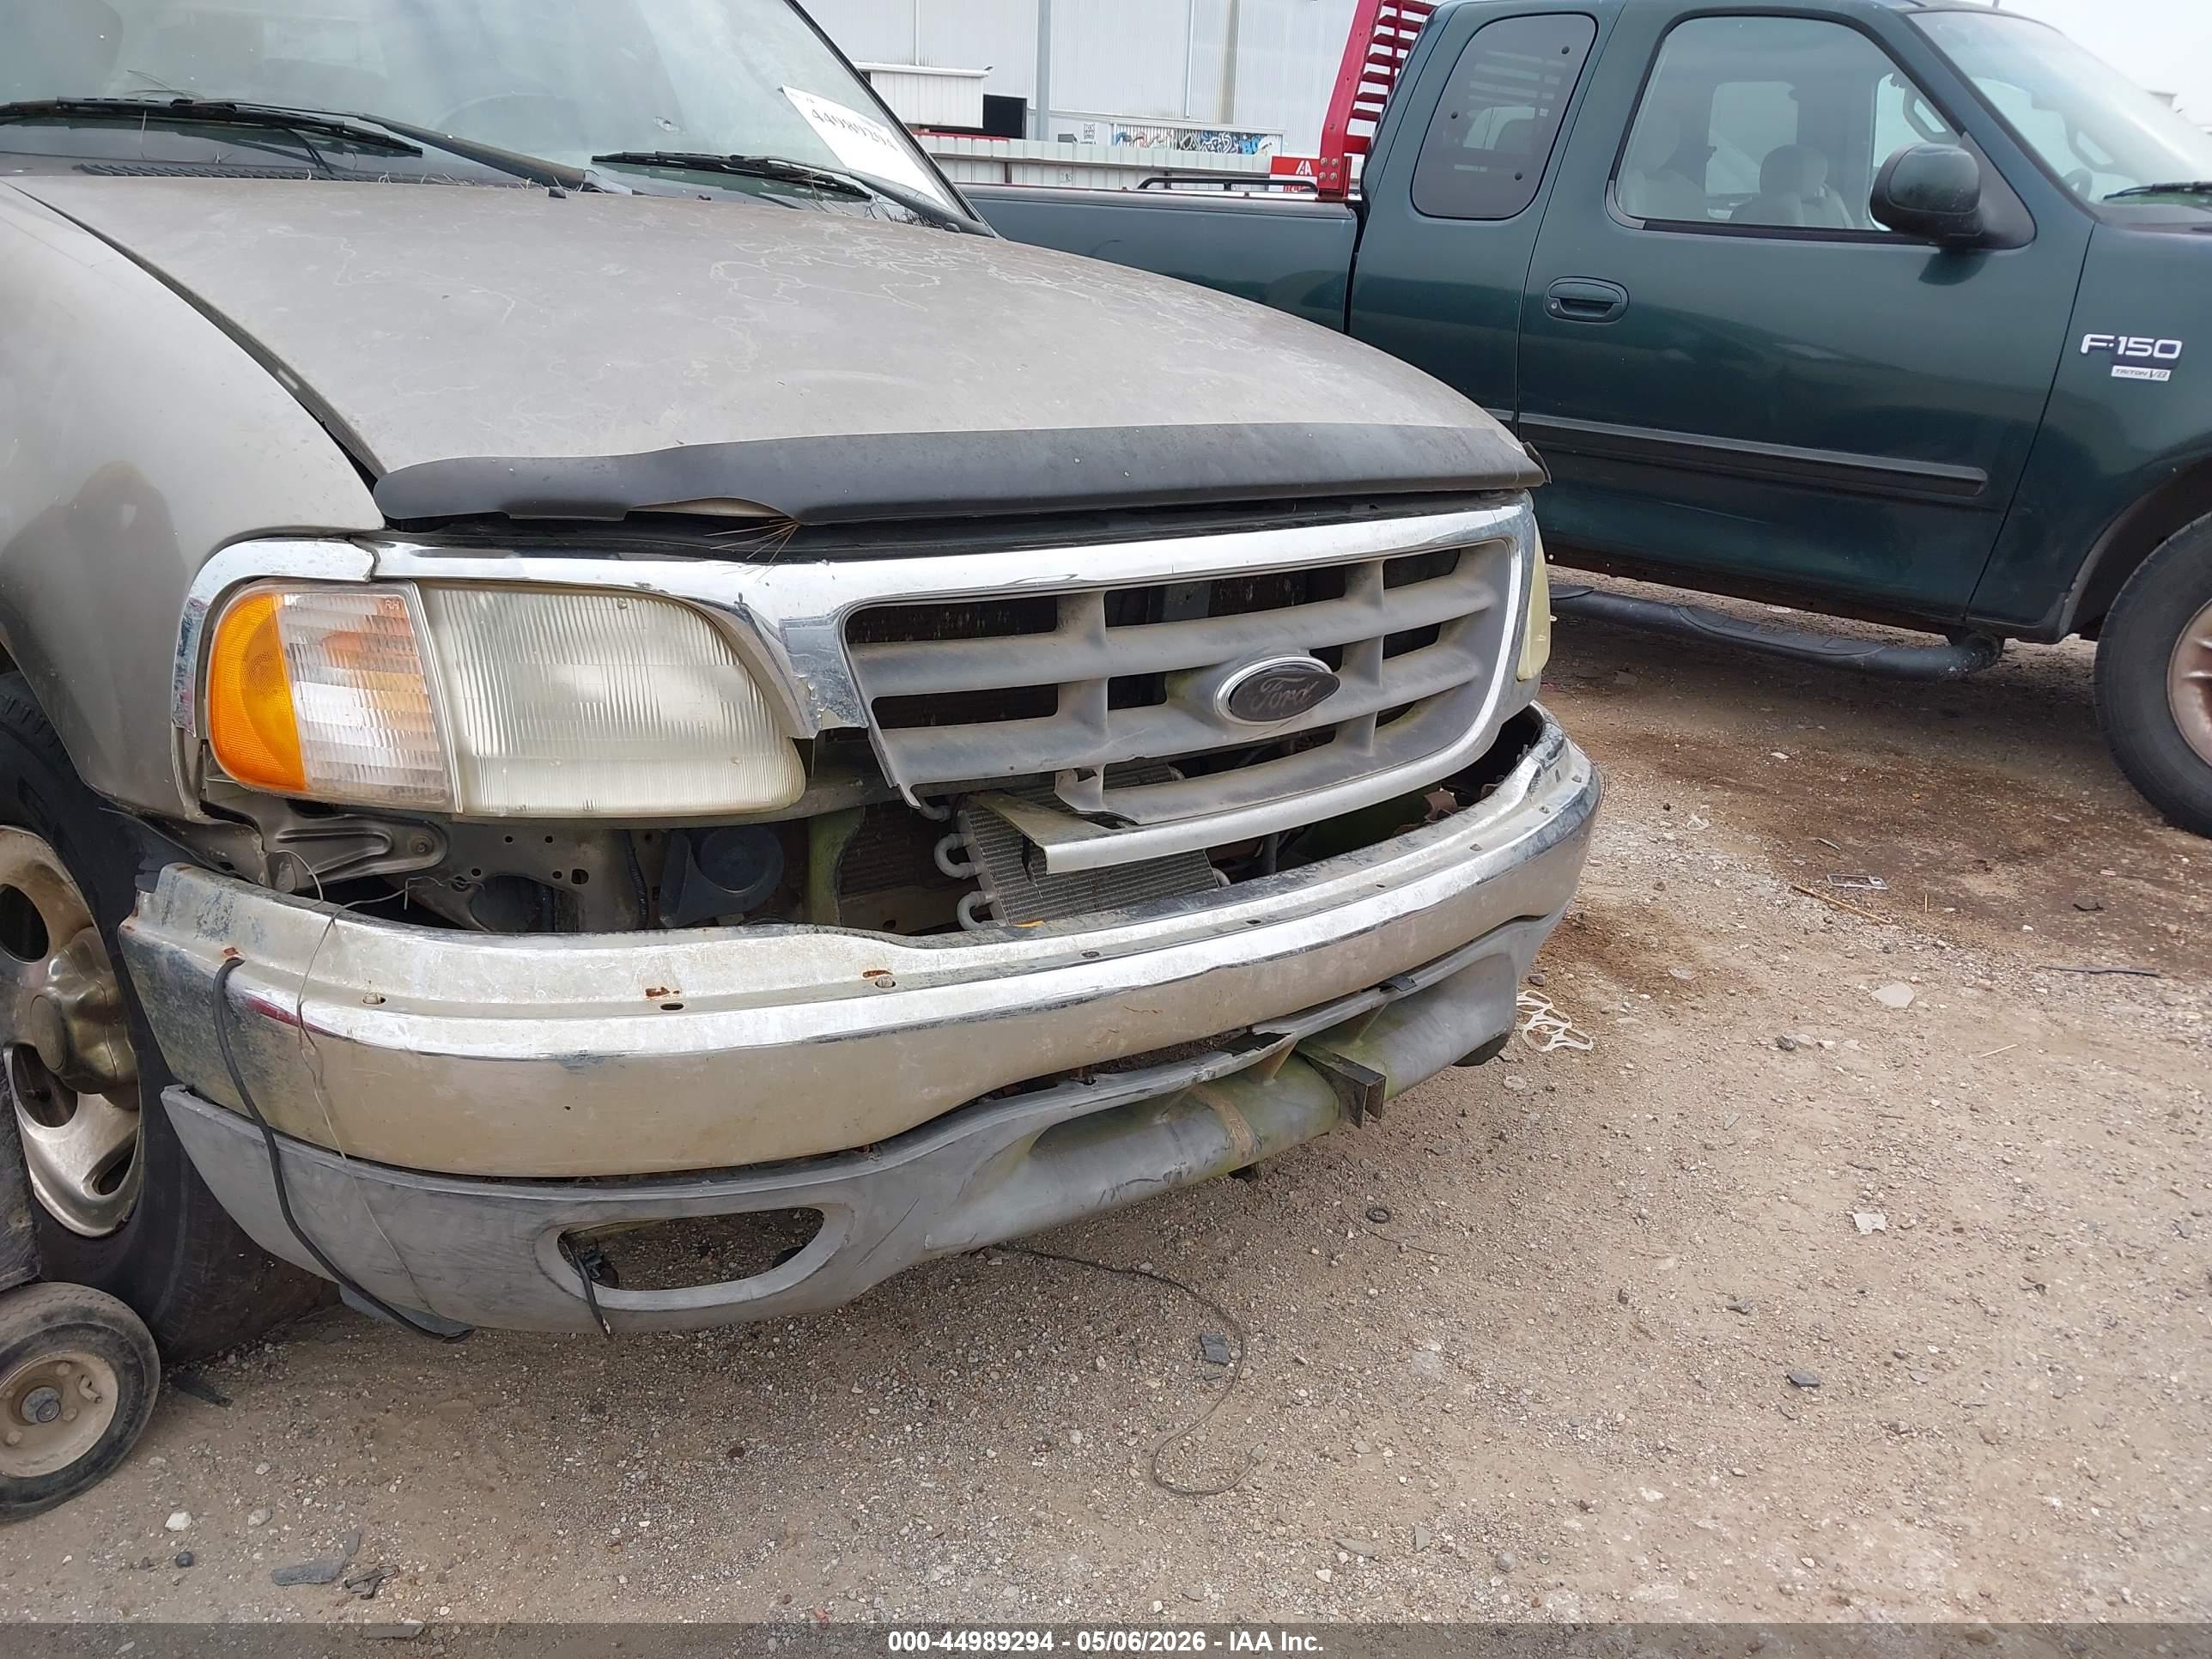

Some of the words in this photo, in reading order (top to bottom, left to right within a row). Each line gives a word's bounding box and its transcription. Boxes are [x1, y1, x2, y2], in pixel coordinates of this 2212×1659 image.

[2081, 334, 2182, 359] F-150
[386, 599, 400, 610] RH
[1249, 676, 1320, 711] Ford
